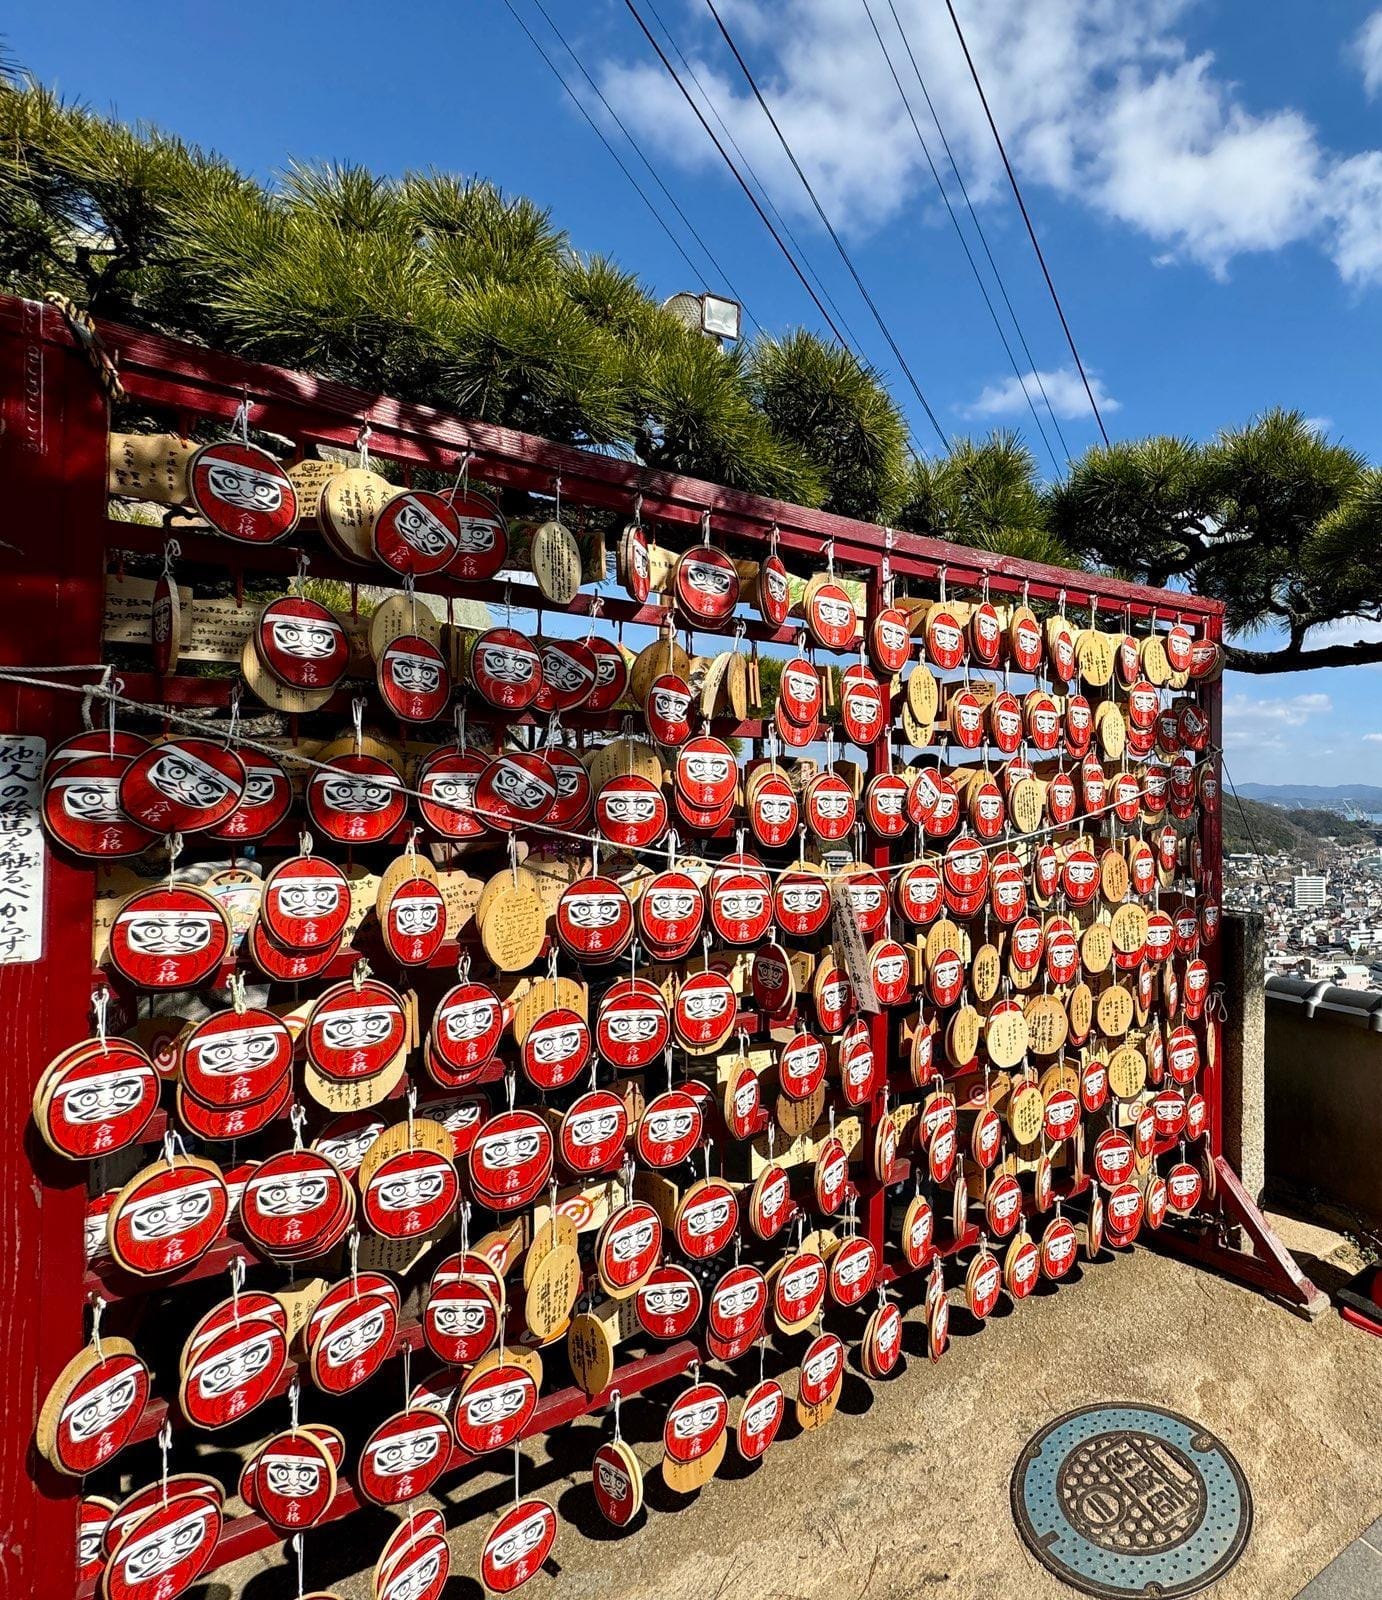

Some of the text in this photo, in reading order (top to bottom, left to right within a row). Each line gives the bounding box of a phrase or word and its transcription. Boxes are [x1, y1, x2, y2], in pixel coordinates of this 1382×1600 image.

[237, 512, 256, 535] 合格
[389, 546, 410, 564] 合格
[462, 556, 477, 575] 合格
[702, 596, 714, 613] 合格
[301, 662, 318, 683] 合格
[501, 685, 515, 704] 合格
[411, 696, 423, 716] 合格
[665, 724, 675, 741] 合格
[703, 786, 714, 802] 合格
[141, 801, 171, 822] 合格
[227, 811, 248, 833] 合格
[349, 816, 369, 837] 合格
[624, 826, 638, 844] 合格
[99, 827, 122, 850] 合格
[302, 921, 318, 943] 合格
[665, 923, 678, 940] 合格
[736, 922, 750, 941] 合格
[797, 915, 808, 931] 合格
[411, 938, 424, 959] 合格
[588, 930, 603, 949] 合格
[156, 958, 180, 983] 合格
[701, 1022, 712, 1039] 合格
[349, 1050, 368, 1073] 合格
[466, 1041, 478, 1062] 合格
[627, 1045, 640, 1063] 合格
[552, 1064, 564, 1083] 合格
[230, 1076, 252, 1100] 合格
[225, 1110, 247, 1133] 合格
[93, 1123, 115, 1150] 合格
[589, 1146, 601, 1166] 合格
[662, 1144, 675, 1162] 合格
[505, 1169, 520, 1190] 合格
[283, 1218, 303, 1242] 合格
[404, 1210, 421, 1232] 合格
[163, 1238, 185, 1264] 合格
[704, 1235, 717, 1253] 合格
[627, 1260, 638, 1280] 合格
[853, 1283, 863, 1299] 合格
[664, 1317, 676, 1334] 合格
[734, 1316, 745, 1334] 合格
[454, 1339, 468, 1359] 合格
[350, 1359, 366, 1382] 合格
[818, 1381, 828, 1397] 合格
[228, 1390, 250, 1418] 合格
[488, 1424, 504, 1446] 合格
[96, 1431, 115, 1461] 合格
[690, 1437, 702, 1456] 合格
[395, 1475, 414, 1498] 合格
[1106, 1450, 1186, 1518] 空気弁
[286, 1500, 301, 1522] 合格
[515, 1560, 531, 1583] 合格
